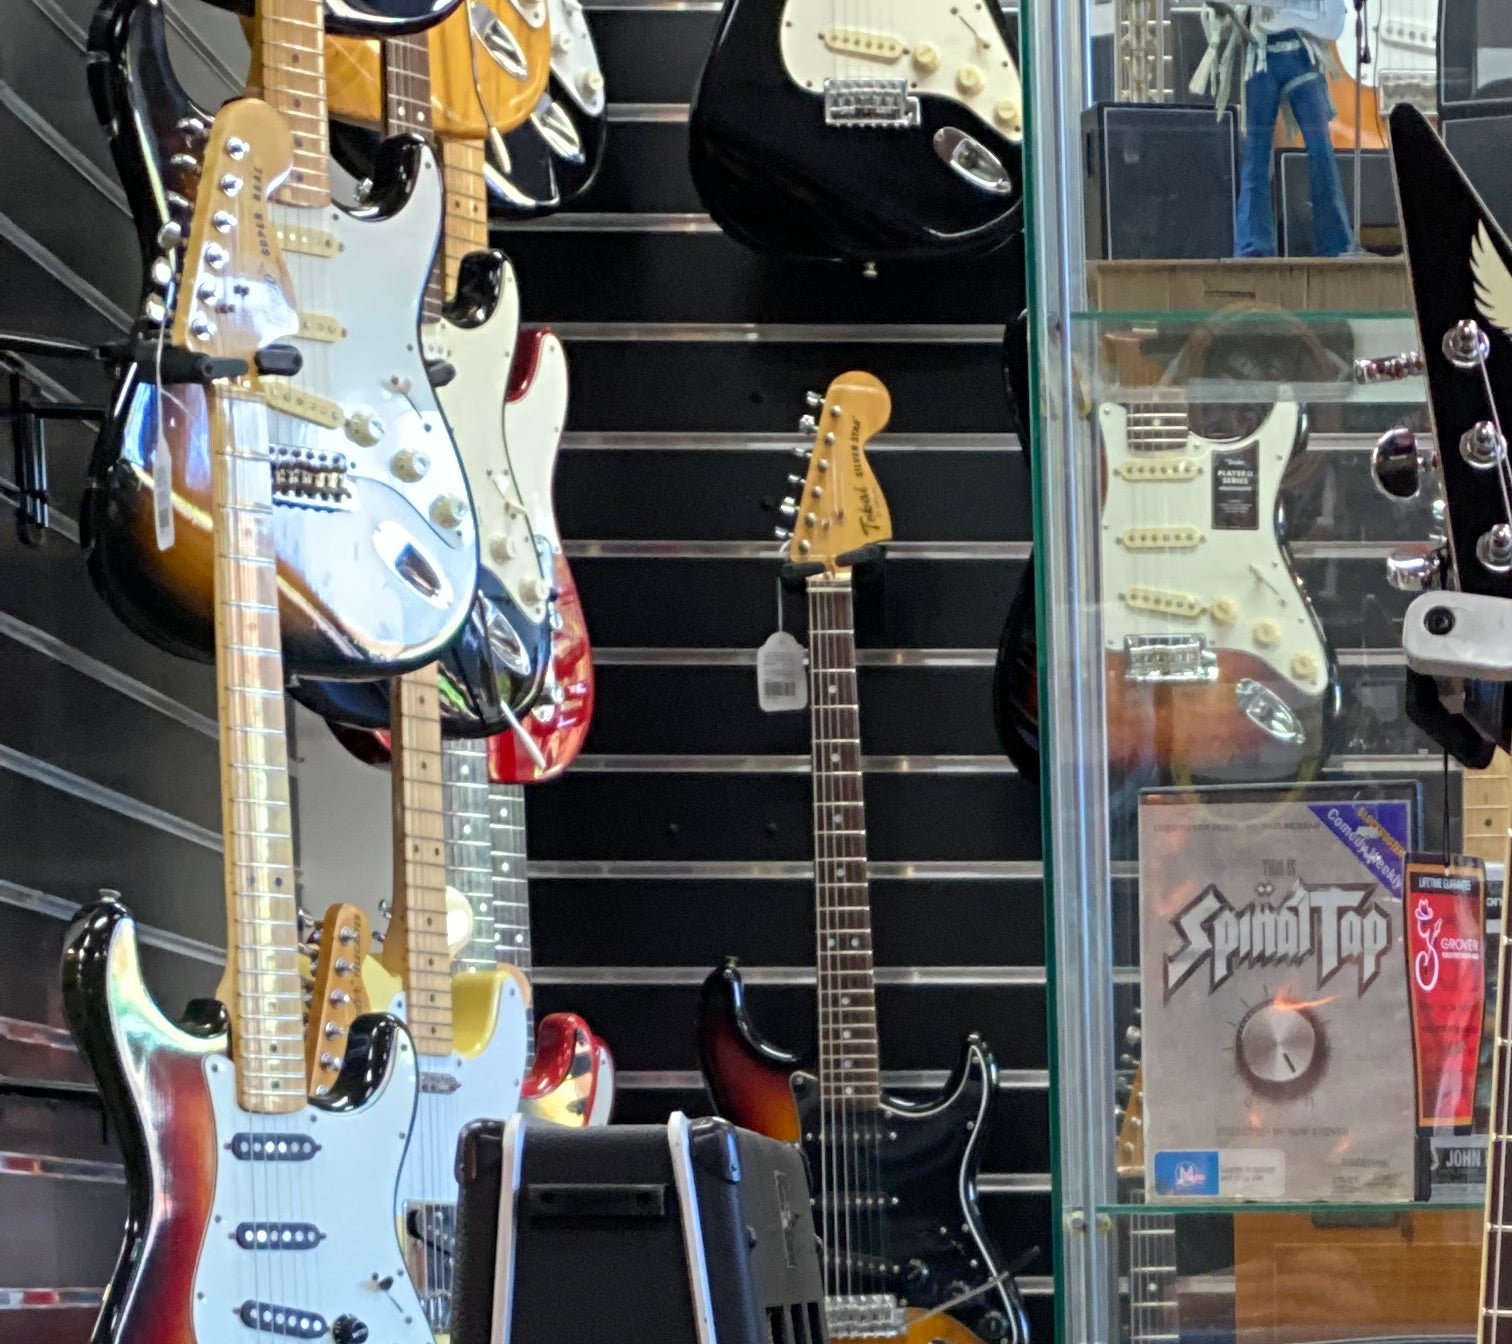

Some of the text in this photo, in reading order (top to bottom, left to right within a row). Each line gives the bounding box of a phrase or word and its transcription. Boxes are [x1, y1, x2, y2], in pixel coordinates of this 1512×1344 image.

[1326, 807, 1405, 891] Comedy Weekly
[1307, 883, 1393, 999] Tap
[1441, 938, 1479, 951] GROVER
[1446, 1149, 1481, 1168] JOHN
